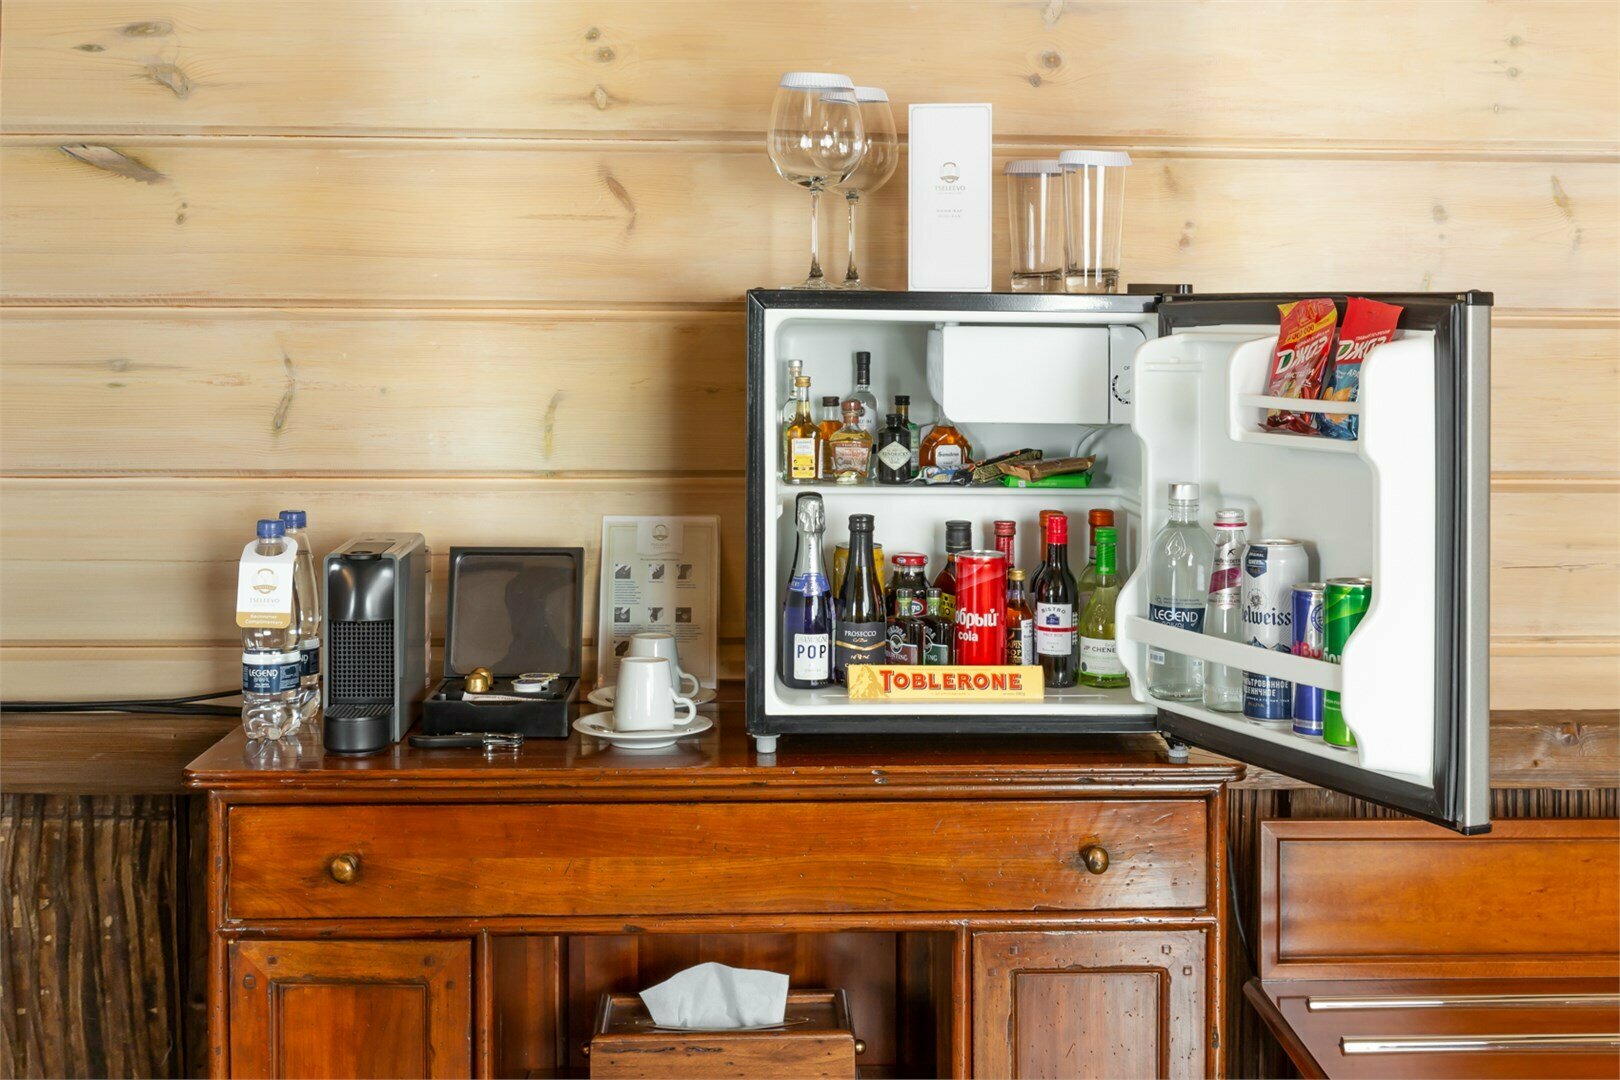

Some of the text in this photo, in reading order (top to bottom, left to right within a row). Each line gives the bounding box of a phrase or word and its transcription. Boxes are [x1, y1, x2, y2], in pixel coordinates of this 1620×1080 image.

[955, 607, 998, 629] обрый
[1154, 609, 1198, 625] LEGEND
[1242, 604, 1291, 626] elweiss
[958, 631, 979, 642] cola
[797, 645, 827, 659] POP
[248, 669, 279, 679] LEGEND
[879, 670, 1023, 693] TOBLERONE
